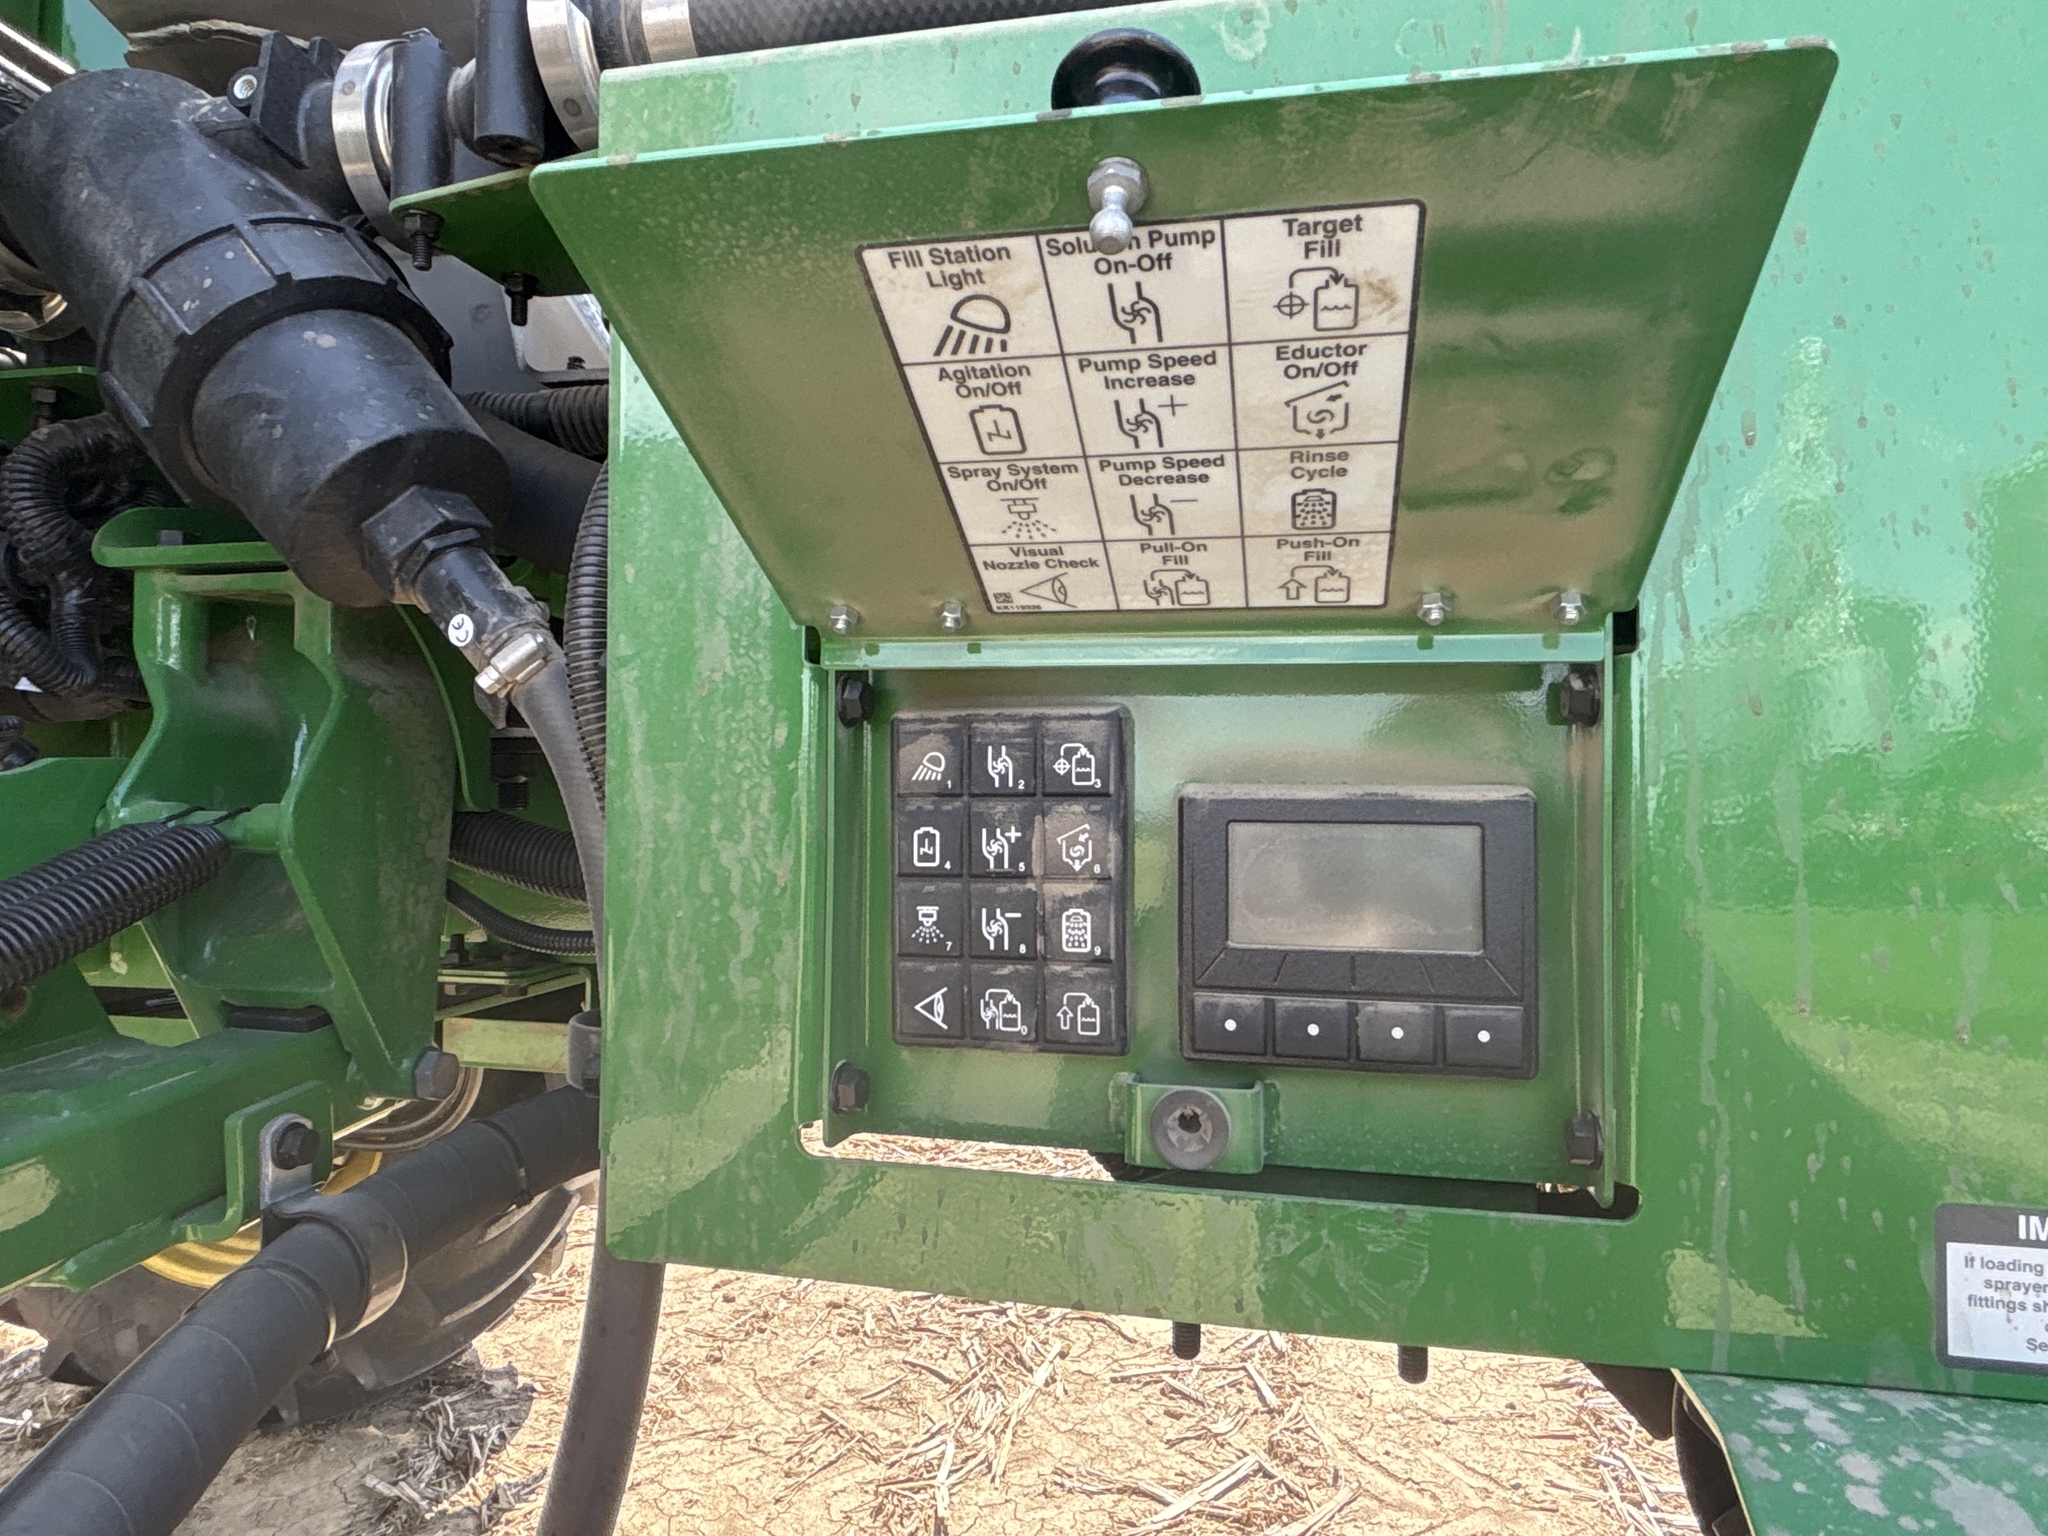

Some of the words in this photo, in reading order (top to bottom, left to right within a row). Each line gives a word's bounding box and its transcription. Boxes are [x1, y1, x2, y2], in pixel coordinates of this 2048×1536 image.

[1282, 214, 1363, 239] Target
[1046, 235, 1141, 256] Solun
[1148, 229, 1216, 249] Pump
[1304, 239, 1341, 259] Fill
[887, 249, 924, 269] Fill
[928, 244, 1011, 266] Station
[1094, 252, 1173, 275] On-Off
[926, 268, 986, 291] Light
[1276, 343, 1367, 361] Eductor
[1078, 357, 1141, 374] Pump
[1147, 350, 1217, 371] Speed
[938, 363, 1031, 384] Agitation
[1283, 360, 1358, 379] On/Off
[1103, 374, 1196, 389] Increase
[955, 381, 1022, 398] On/Off
[1098, 459, 1156, 473] Pump
[1162, 454, 1225, 471] Speed
[1289, 450, 1350, 464] Rinse
[947, 466, 1001, 481] Spray
[1007, 463, 1079, 478] System
[1290, 465, 1348, 482] Cycle
[986, 477, 1047, 491] On/Off
[1118, 473, 1210, 486] Decrease
[1140, 541, 1208, 553] Pull-On
[1276, 536, 1360, 549] Push-On
[1009, 545, 1064, 557] Visual
[1304, 551, 1332, 561] Fill
[983, 559, 1040, 571] Nozzle
[1044, 557, 1100, 569] Check
[1162, 555, 1189, 565] Fill
[946, 780, 952, 789] 1
[1018, 780, 1025, 790] 2
[1094, 779, 1102, 789] 3
[944, 860, 951, 870] 4
[1019, 862, 1026, 872] 5
[1094, 864, 1101, 874] 6
[945, 942, 952, 951] 7
[1019, 943, 1027, 954] 8
[1094, 946, 1102, 956] 9
[1964, 1256, 1976, 1269] If
[1980, 1256, 2044, 1277] loading
[1967, 1294, 2028, 1314] fittings
